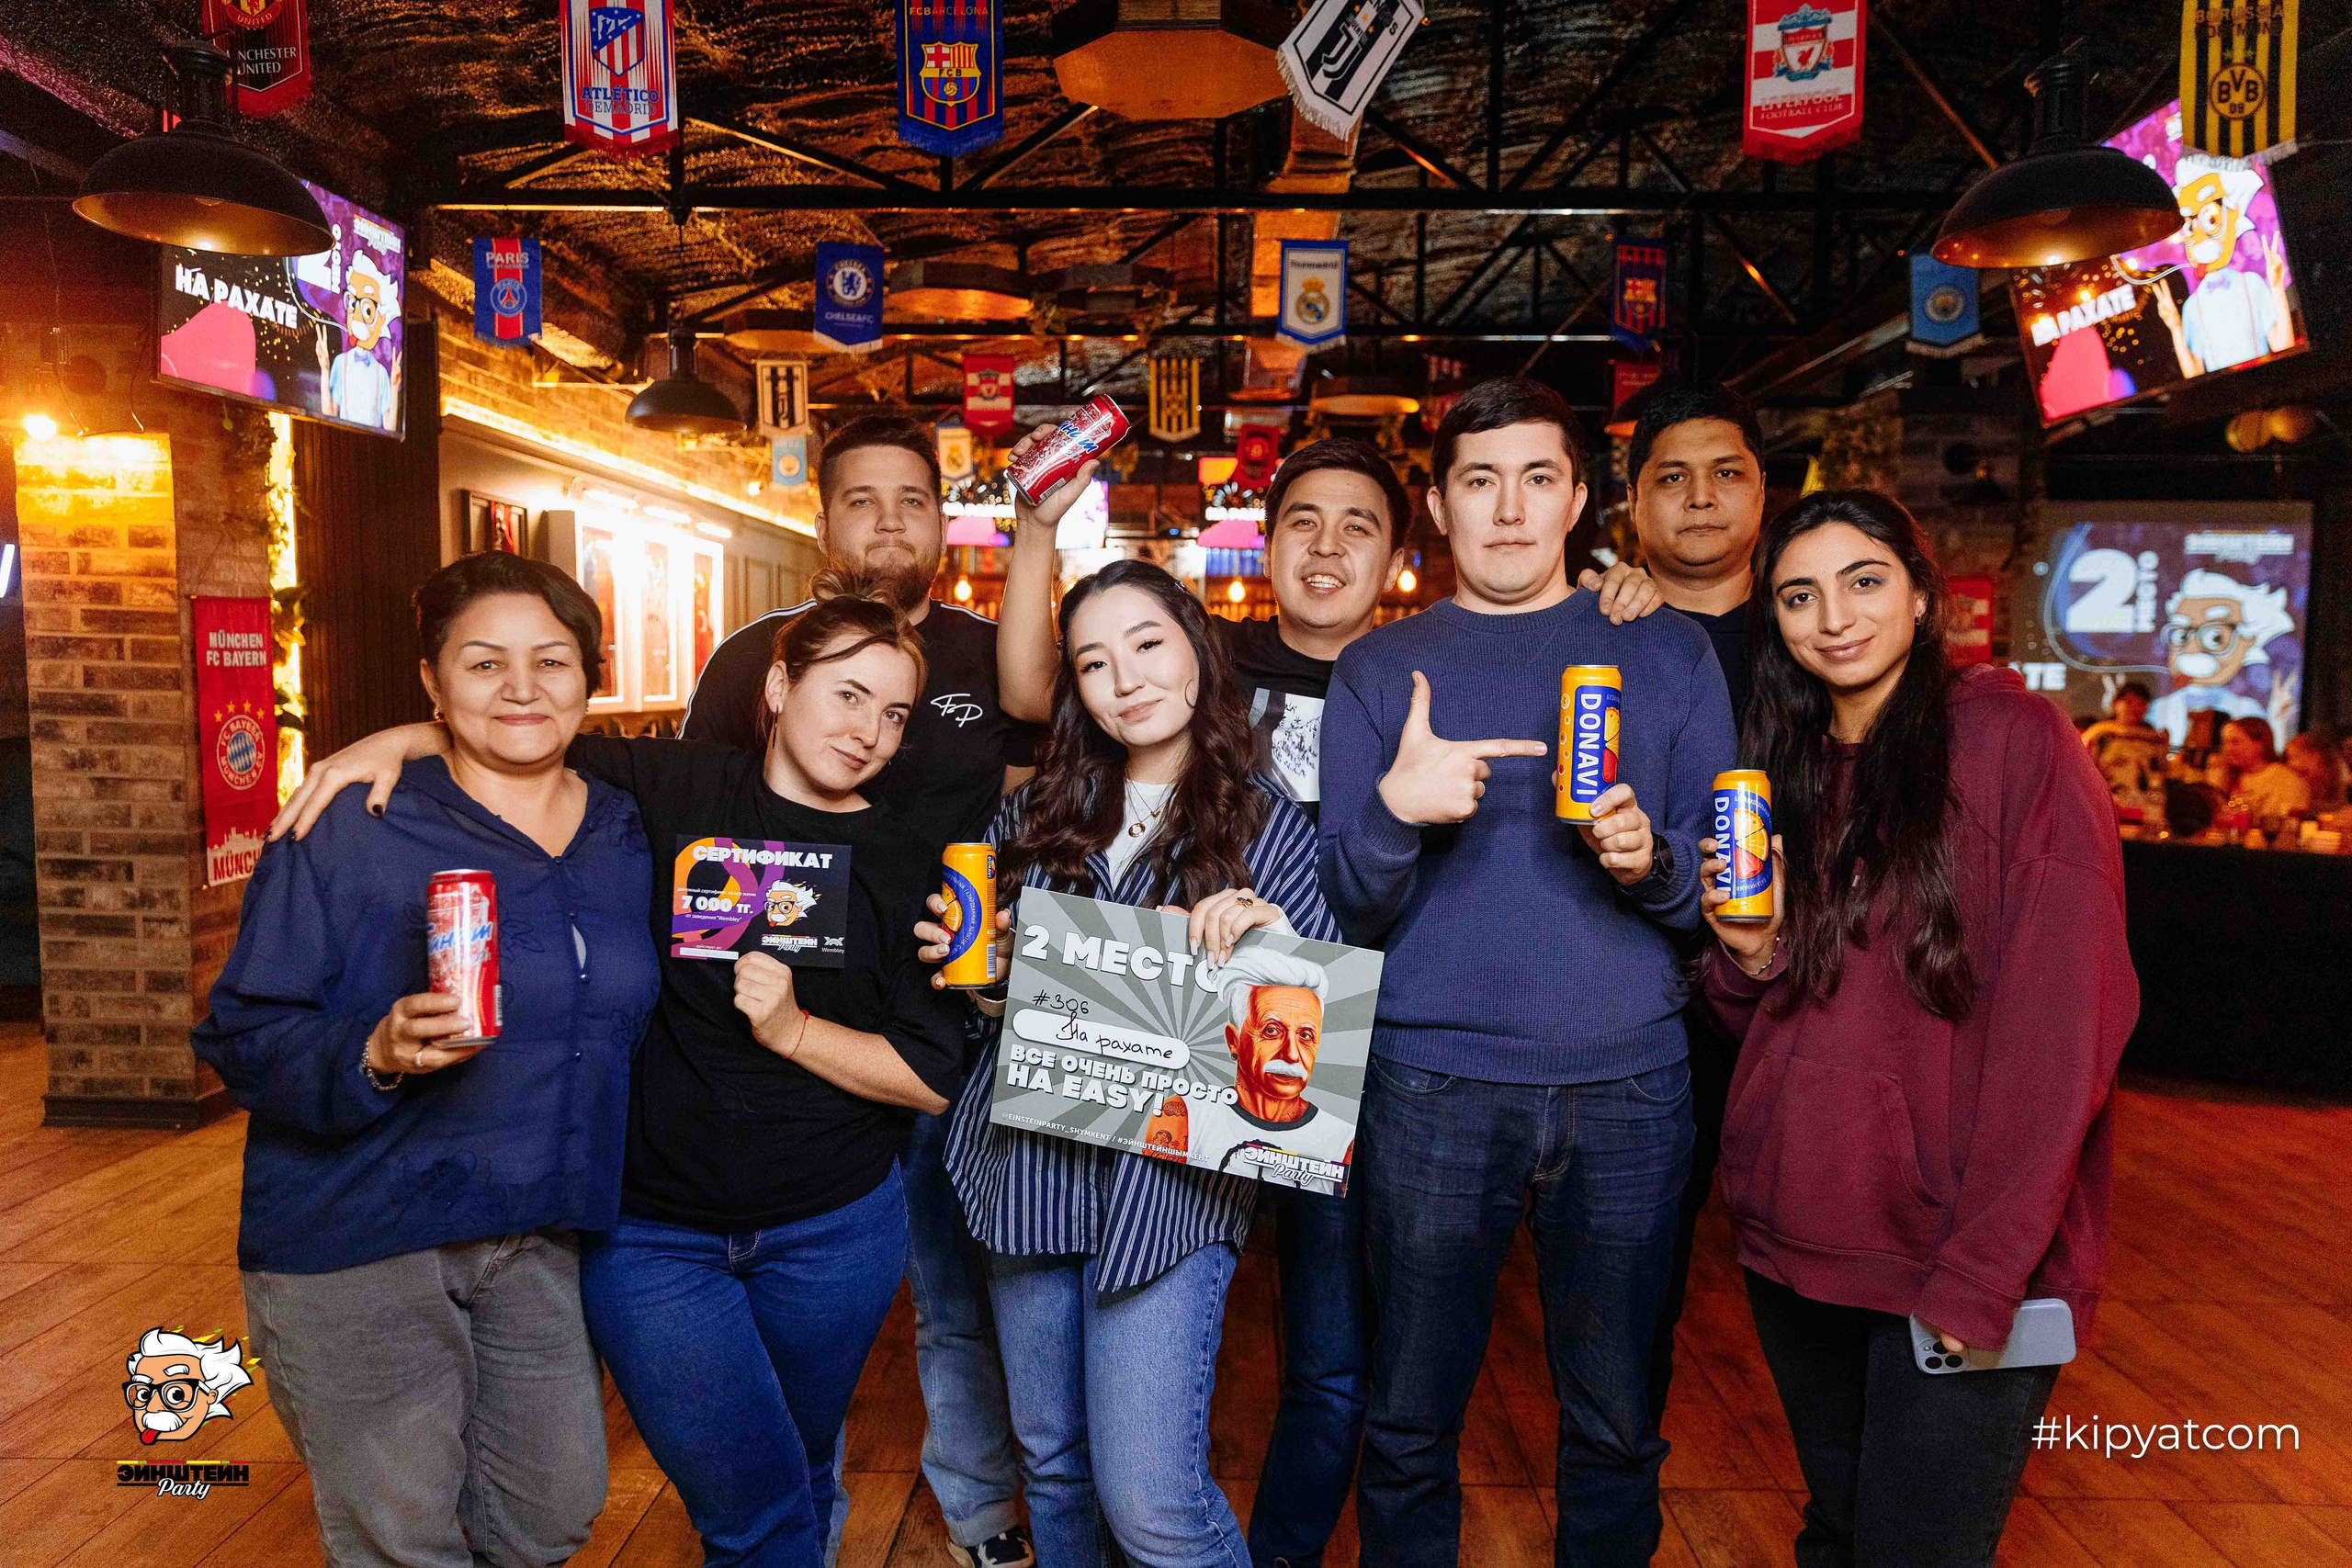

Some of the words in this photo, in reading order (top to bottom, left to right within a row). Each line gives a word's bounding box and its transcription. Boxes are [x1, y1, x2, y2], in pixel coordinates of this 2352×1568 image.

[237, 13, 273, 25] UNITED
[237, 47, 297, 61] NCHESTER
[581, 85, 660, 102] ATLÉTICO
[2218, 70, 2259, 104] BVB
[485, 251, 529, 265] PARIS
[212, 278, 297, 329] РАХАТЕ
[2067, 548, 2138, 633] 2
[209, 629, 264, 649] MÜNCHEN
[206, 650, 220, 667] FC
[223, 650, 266, 668] BAYERN
[1577, 694, 1602, 795] DONAVI
[692, 845, 832, 869] СЕРТИФИКАТ
[1022, 924, 1050, 961] 2
[1033, 989, 1089, 1014] #306
[1011, 1044, 1057, 1068] ВСЕ
[1061, 1055, 1136, 1084] ОЧЕНЬ
[1141, 1071, 1238, 1103] ПРОСТО
[1007, 1064, 1054, 1094] НА
[1062, 1074, 1165, 1117] EASY!
[1001, 1111, 1111, 1141] @EINSTEINPARTY_SHYMKENT
[1272, 1163, 1315, 1186] Party
